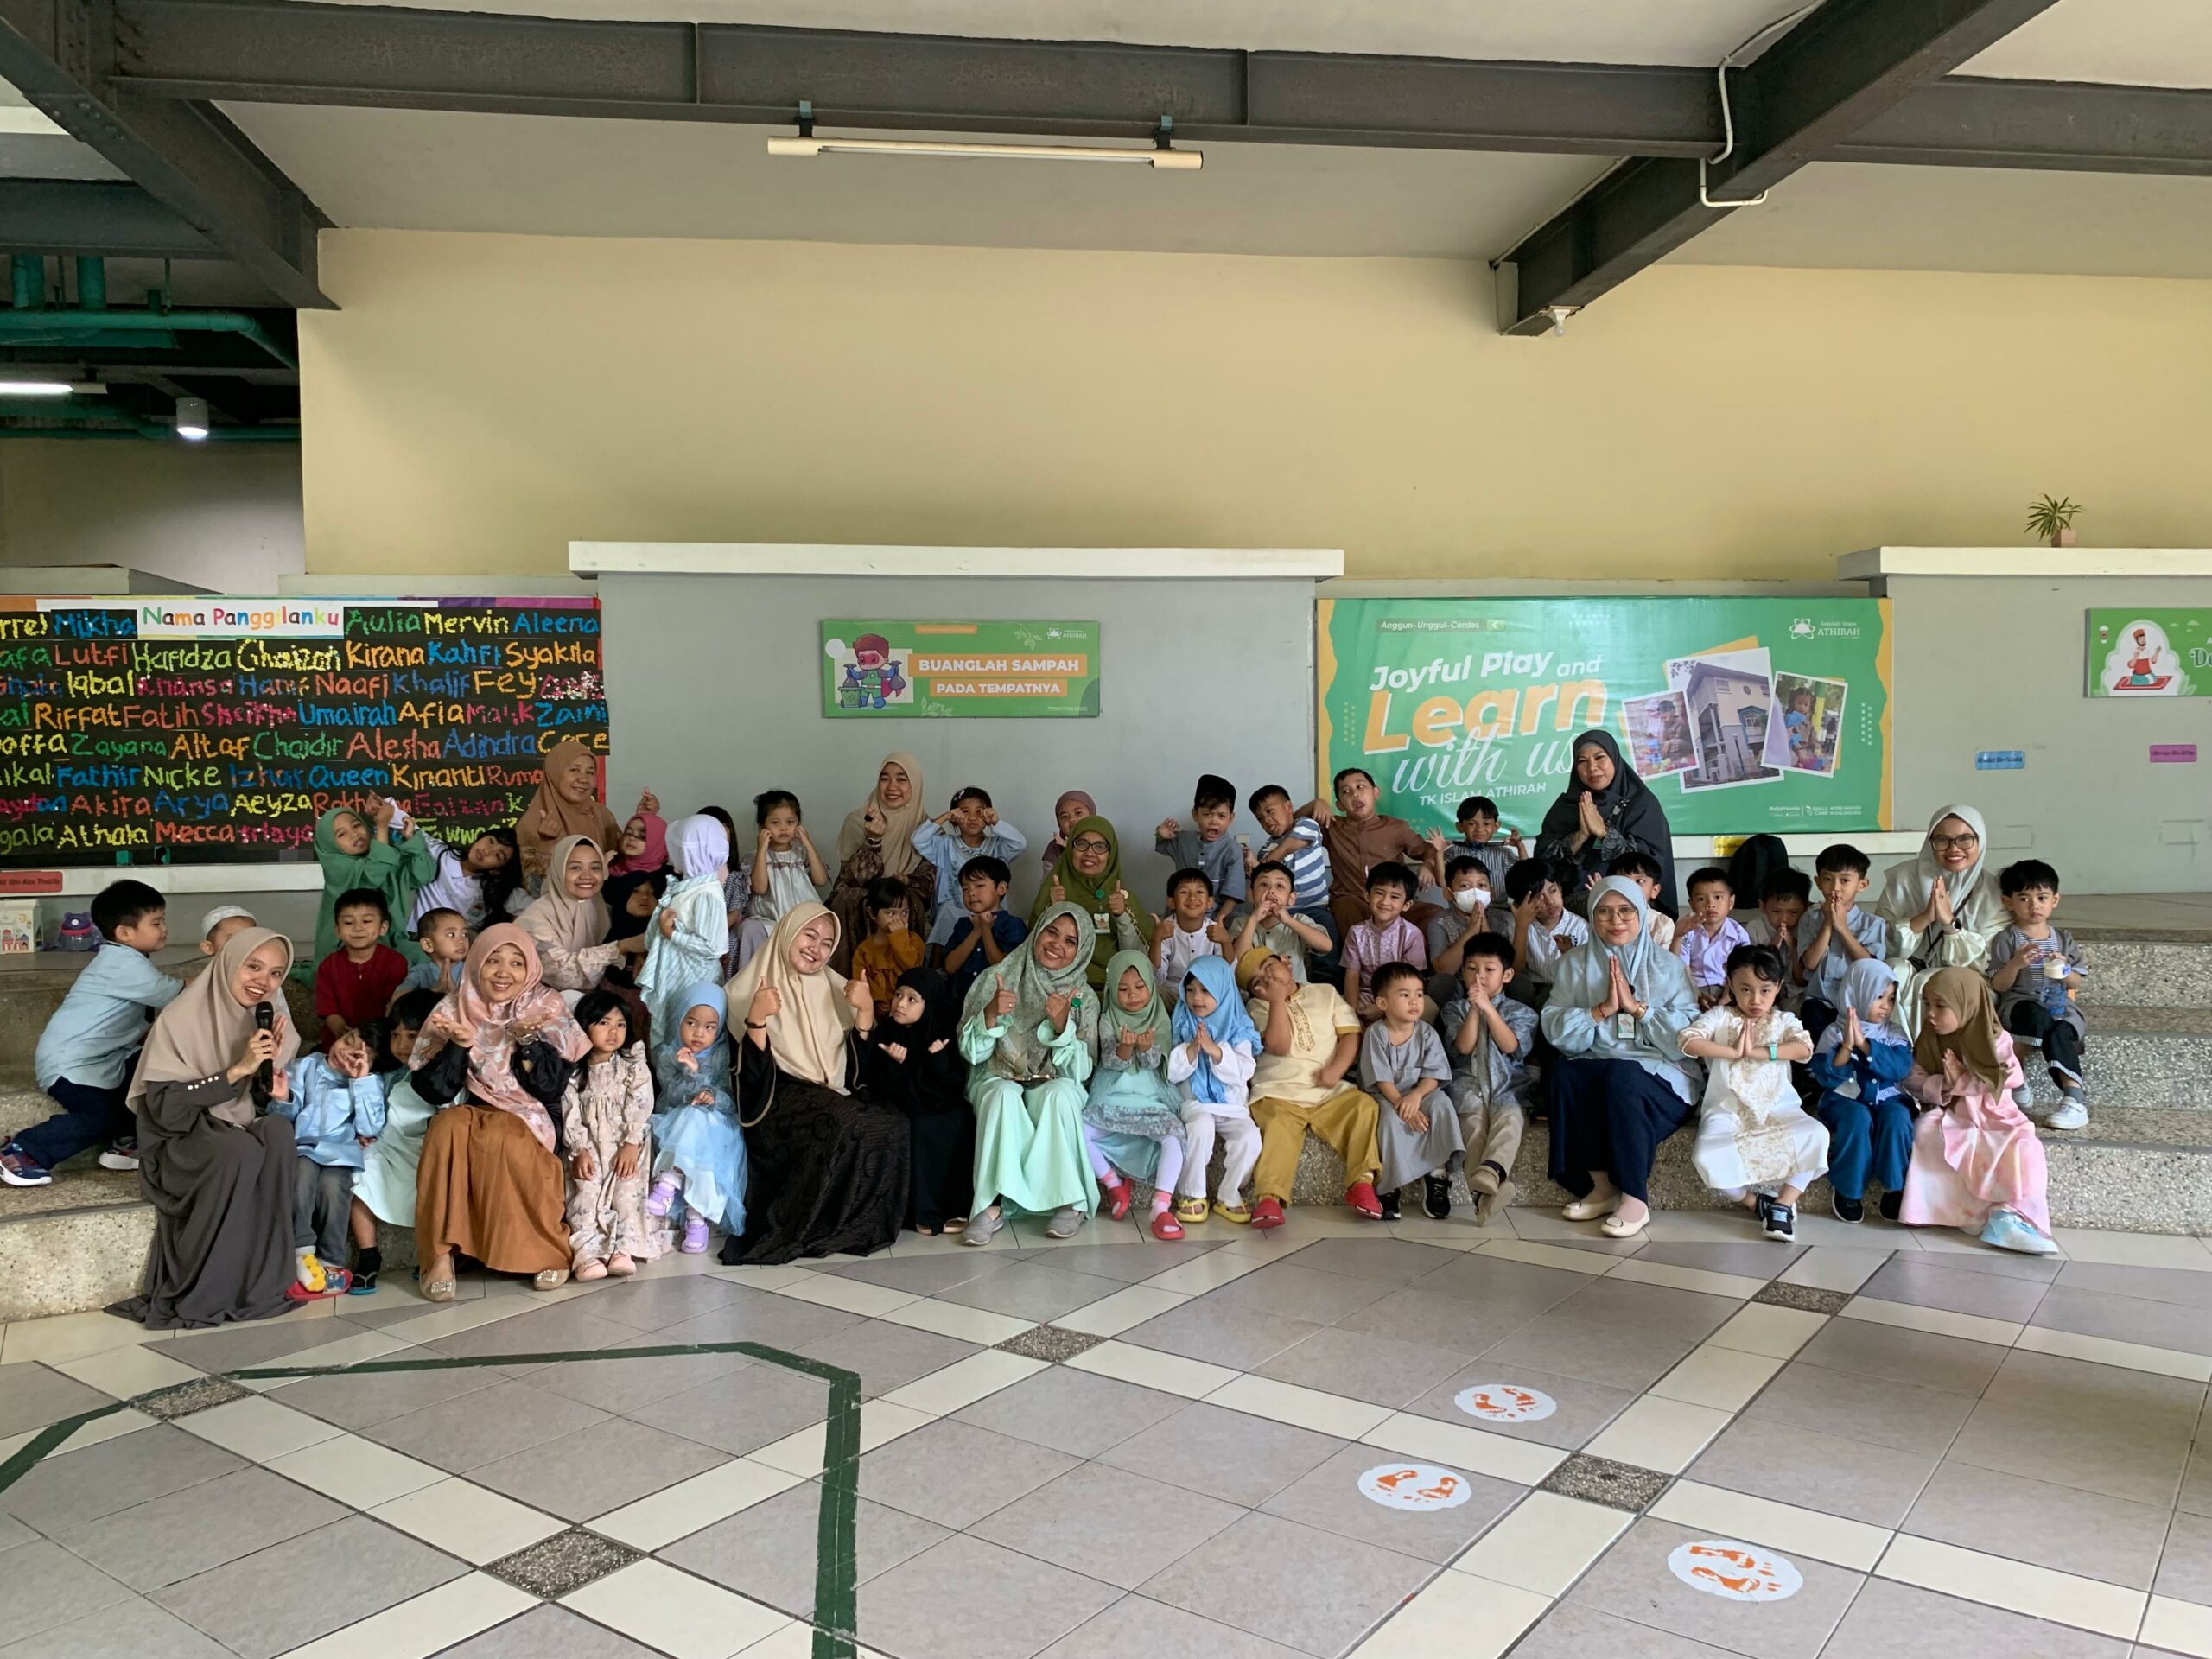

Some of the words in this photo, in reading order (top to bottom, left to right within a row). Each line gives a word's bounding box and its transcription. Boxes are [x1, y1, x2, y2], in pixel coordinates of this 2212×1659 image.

[54, 610, 137, 639] Mikha
[143, 607, 206, 626] Nama
[213, 606, 340, 631] Panggilanku
[345, 609, 422, 635] Aulia
[423, 609, 509, 635] Mervin
[512, 612, 600, 634] Aleena
[1381, 620, 1480, 631] Anggun-Unggul-Cerdas
[54, 642, 128, 667] Lutfi
[131, 642, 232, 672] Hafidza
[346, 640, 424, 669] Kirana
[505, 640, 596, 670] Syakila
[918, 659, 1007, 671] BUANGLAH
[1011, 659, 1079, 671] SAMPAH
[67, 670, 135, 699] Iqbal
[315, 671, 389, 699] Naafi
[392, 670, 471, 697] Khalif
[473, 670, 537, 700] Fey
[1369, 654, 1472, 693] Joyful
[1480, 650, 1554, 679] Play
[1556, 654, 1602, 677] and
[936, 683, 976, 694] PADA
[978, 683, 1061, 694] TEMPATNYA
[35, 702, 122, 731] Riffat
[123, 702, 200, 729] Fatih
[297, 698, 397, 727] Umairah
[398, 701, 465, 728] Afia
[1363, 678, 1608, 756] Learn
[170, 732, 251, 760] Altaf
[346, 728, 442, 760] Alesha
[1391, 722, 1508, 794] with
[1526, 733, 1580, 778] us
[0, 761, 51, 787] ikal
[56, 764, 142, 787] Fathir
[143, 761, 222, 791] Nicke
[308, 765, 388, 789] Queen
[391, 762, 485, 791] Kinanti
[70, 789, 152, 818] Akira
[154, 787, 229, 819] Arya
[230, 793, 312, 817] Aeyza
[1419, 795, 1436, 806] TK
[1486, 782, 1547, 799] ATHIRAH
[155, 820, 235, 843] Mecca
